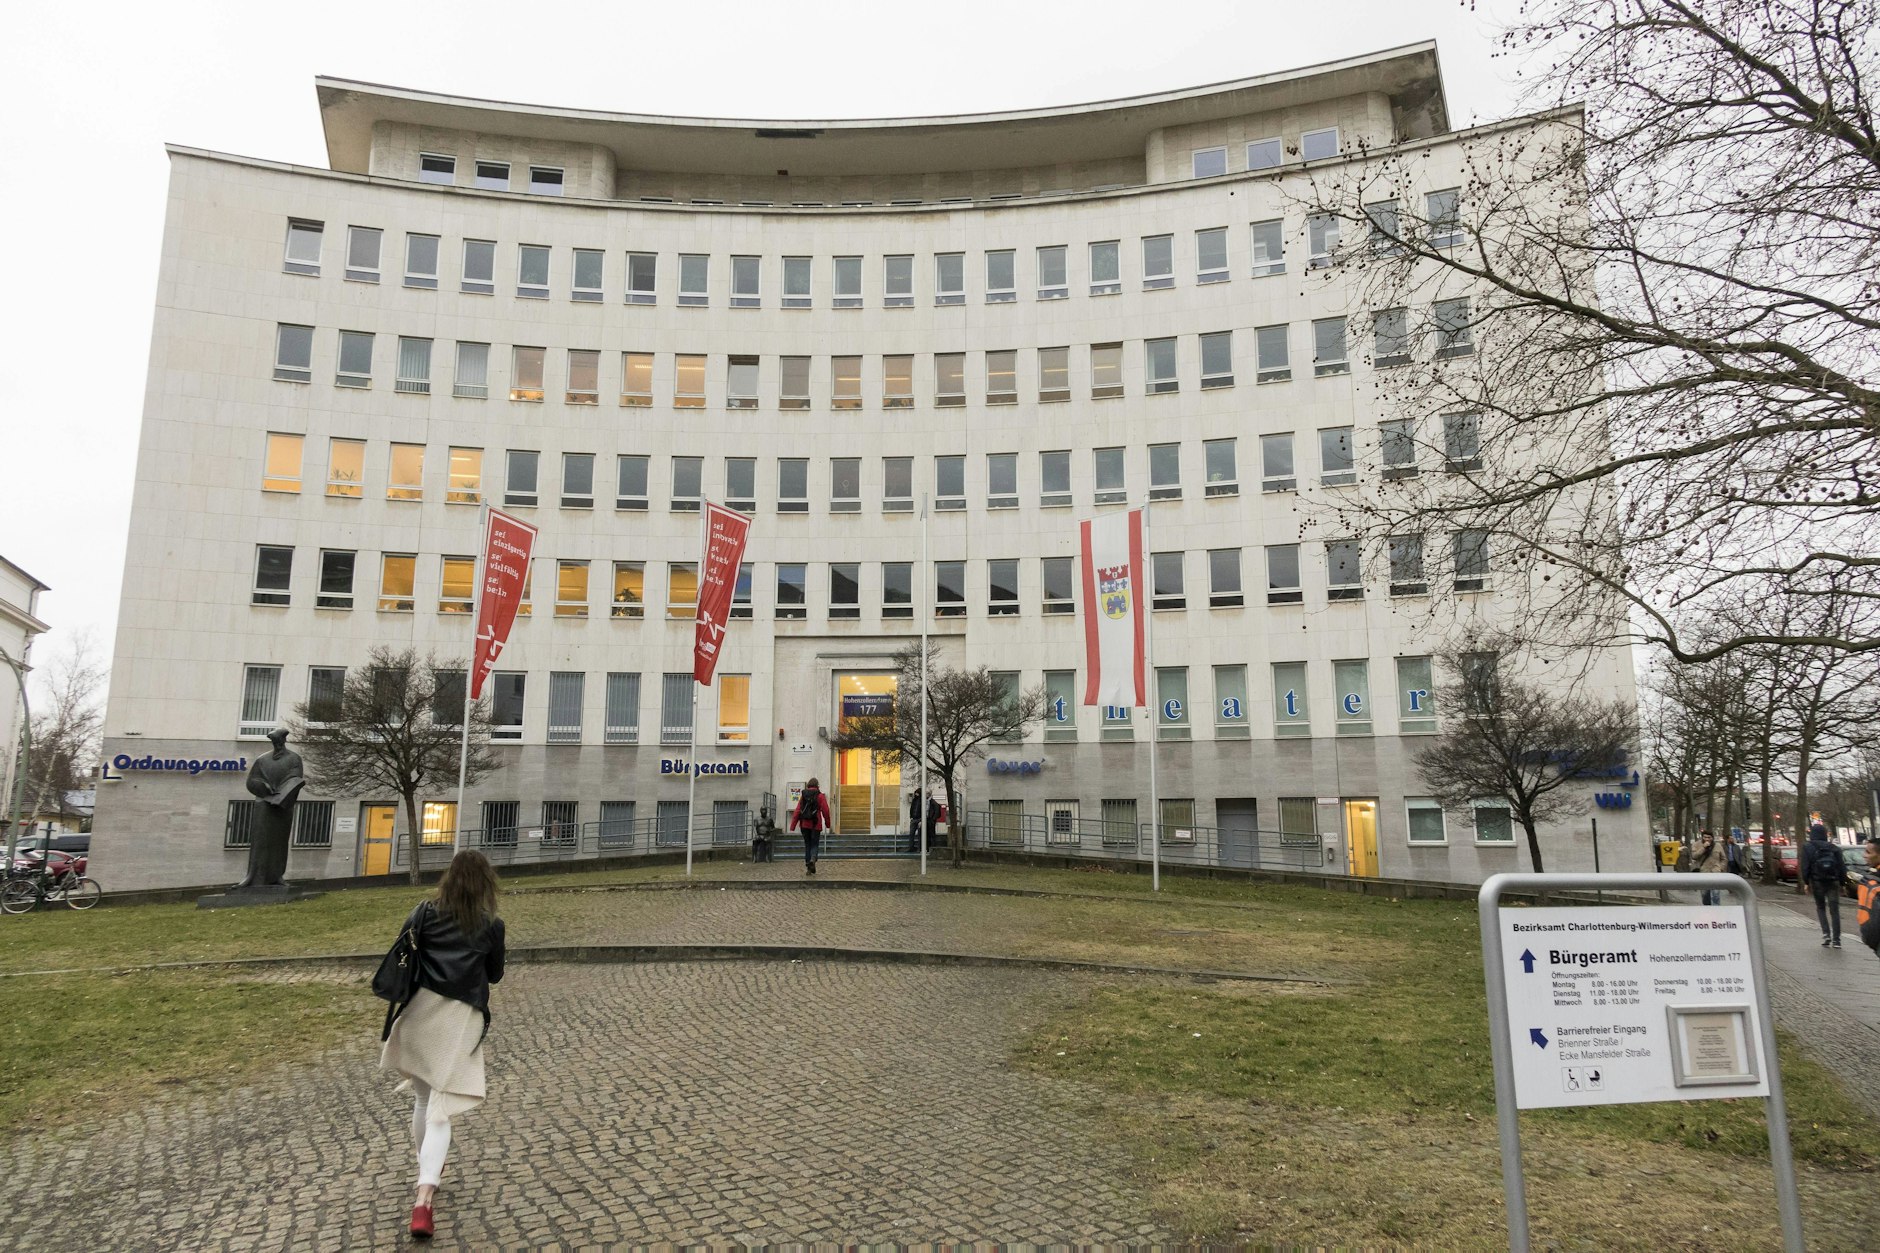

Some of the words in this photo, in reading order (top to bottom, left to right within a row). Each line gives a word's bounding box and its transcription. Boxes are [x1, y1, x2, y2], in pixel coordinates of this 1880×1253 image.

[494, 530, 506, 538] sei
[493, 540, 526, 560] einzigartig
[860, 705, 877, 714] 177
[113, 754, 247, 774] Ordnungsamt
[1513, 923, 1565, 932] Bezirksamt
[1568, 922, 1691, 932] Charlottenburg-Wilmersdorf
[1550, 949, 1638, 968] Bürgeramt
[1649, 954, 1725, 962] Hohenzollerndamm
[1552, 971, 1600, 980] Öffnungszeiten:
[1557, 1026, 1611, 1036] Barrierefreier
[1613, 1025, 1646, 1035] Eingang
[1592, 1037, 1619, 1047] Straße
[1560, 1052, 1579, 1060] Ecke
[1581, 1050, 1623, 1059] Mansfelder
[1625, 1048, 1651, 1057] Straße
